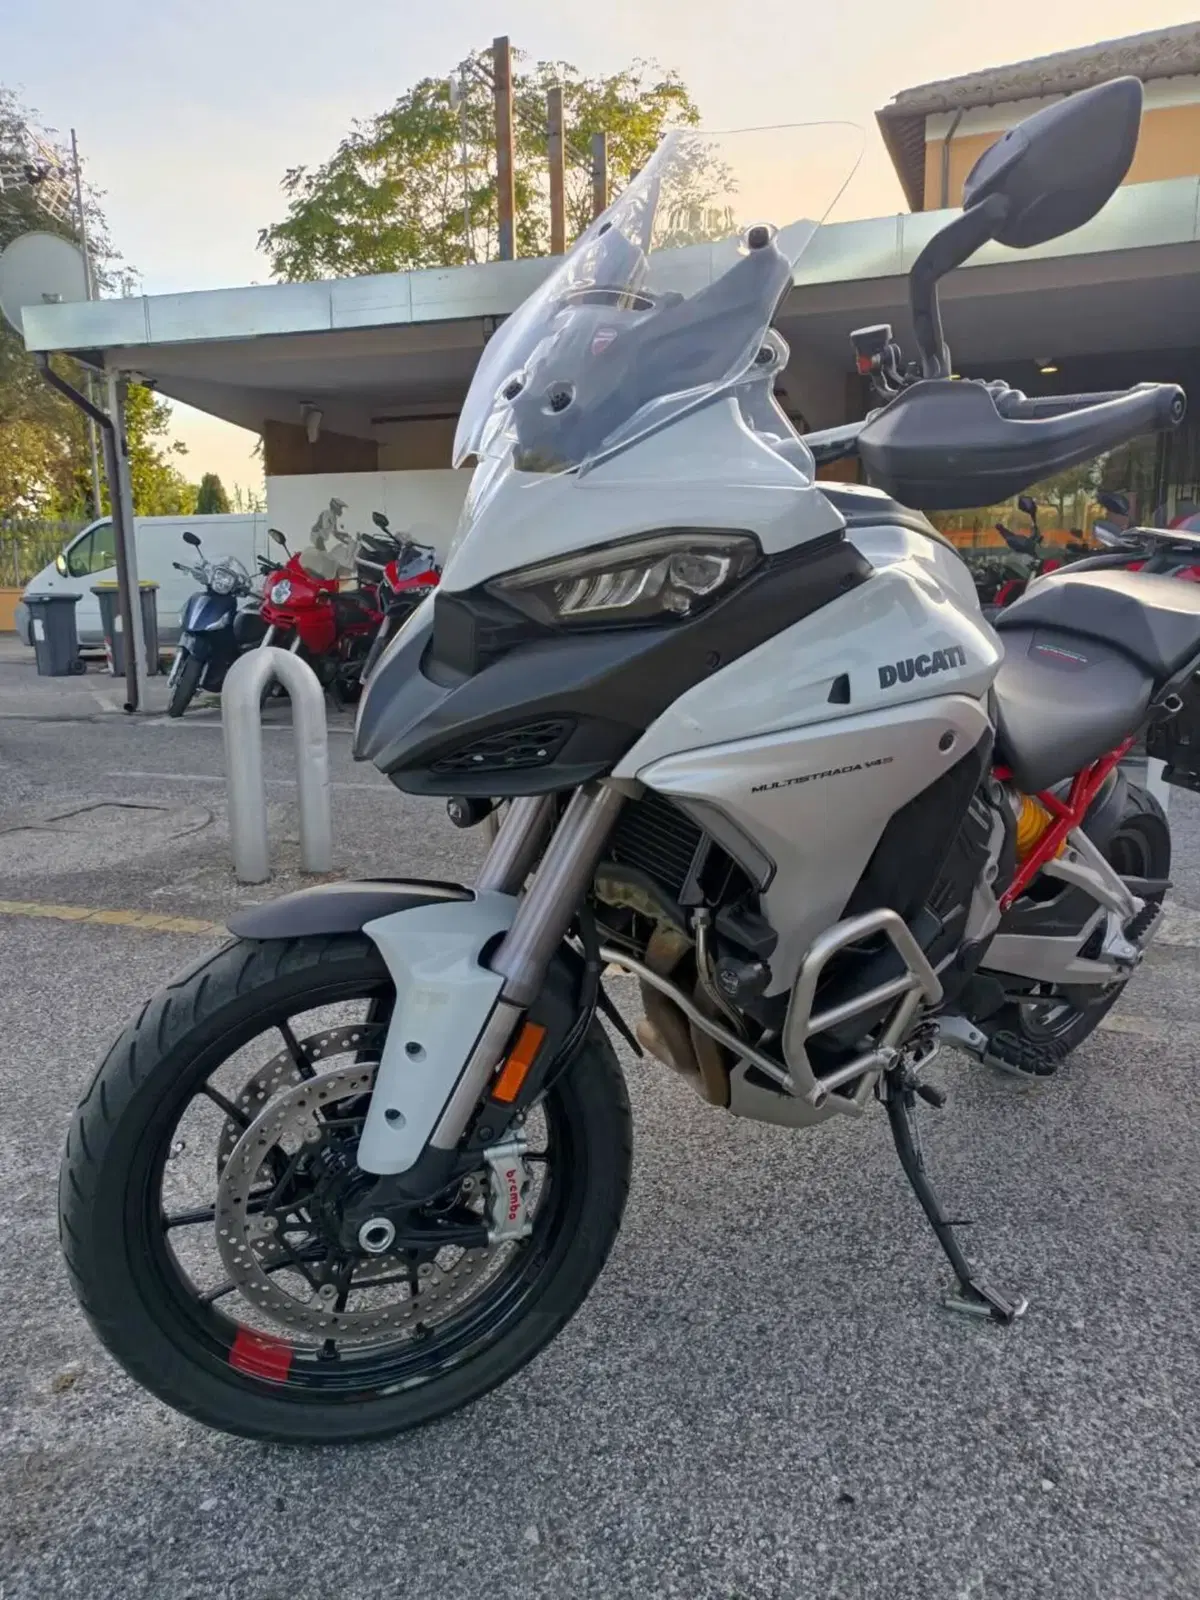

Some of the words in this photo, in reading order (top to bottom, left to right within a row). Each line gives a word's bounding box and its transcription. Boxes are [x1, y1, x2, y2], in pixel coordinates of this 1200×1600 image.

[878, 645, 967, 690] DUCATI
[751, 764, 863, 794] MULTISTRADA
[506, 1169, 520, 1220] brembo
